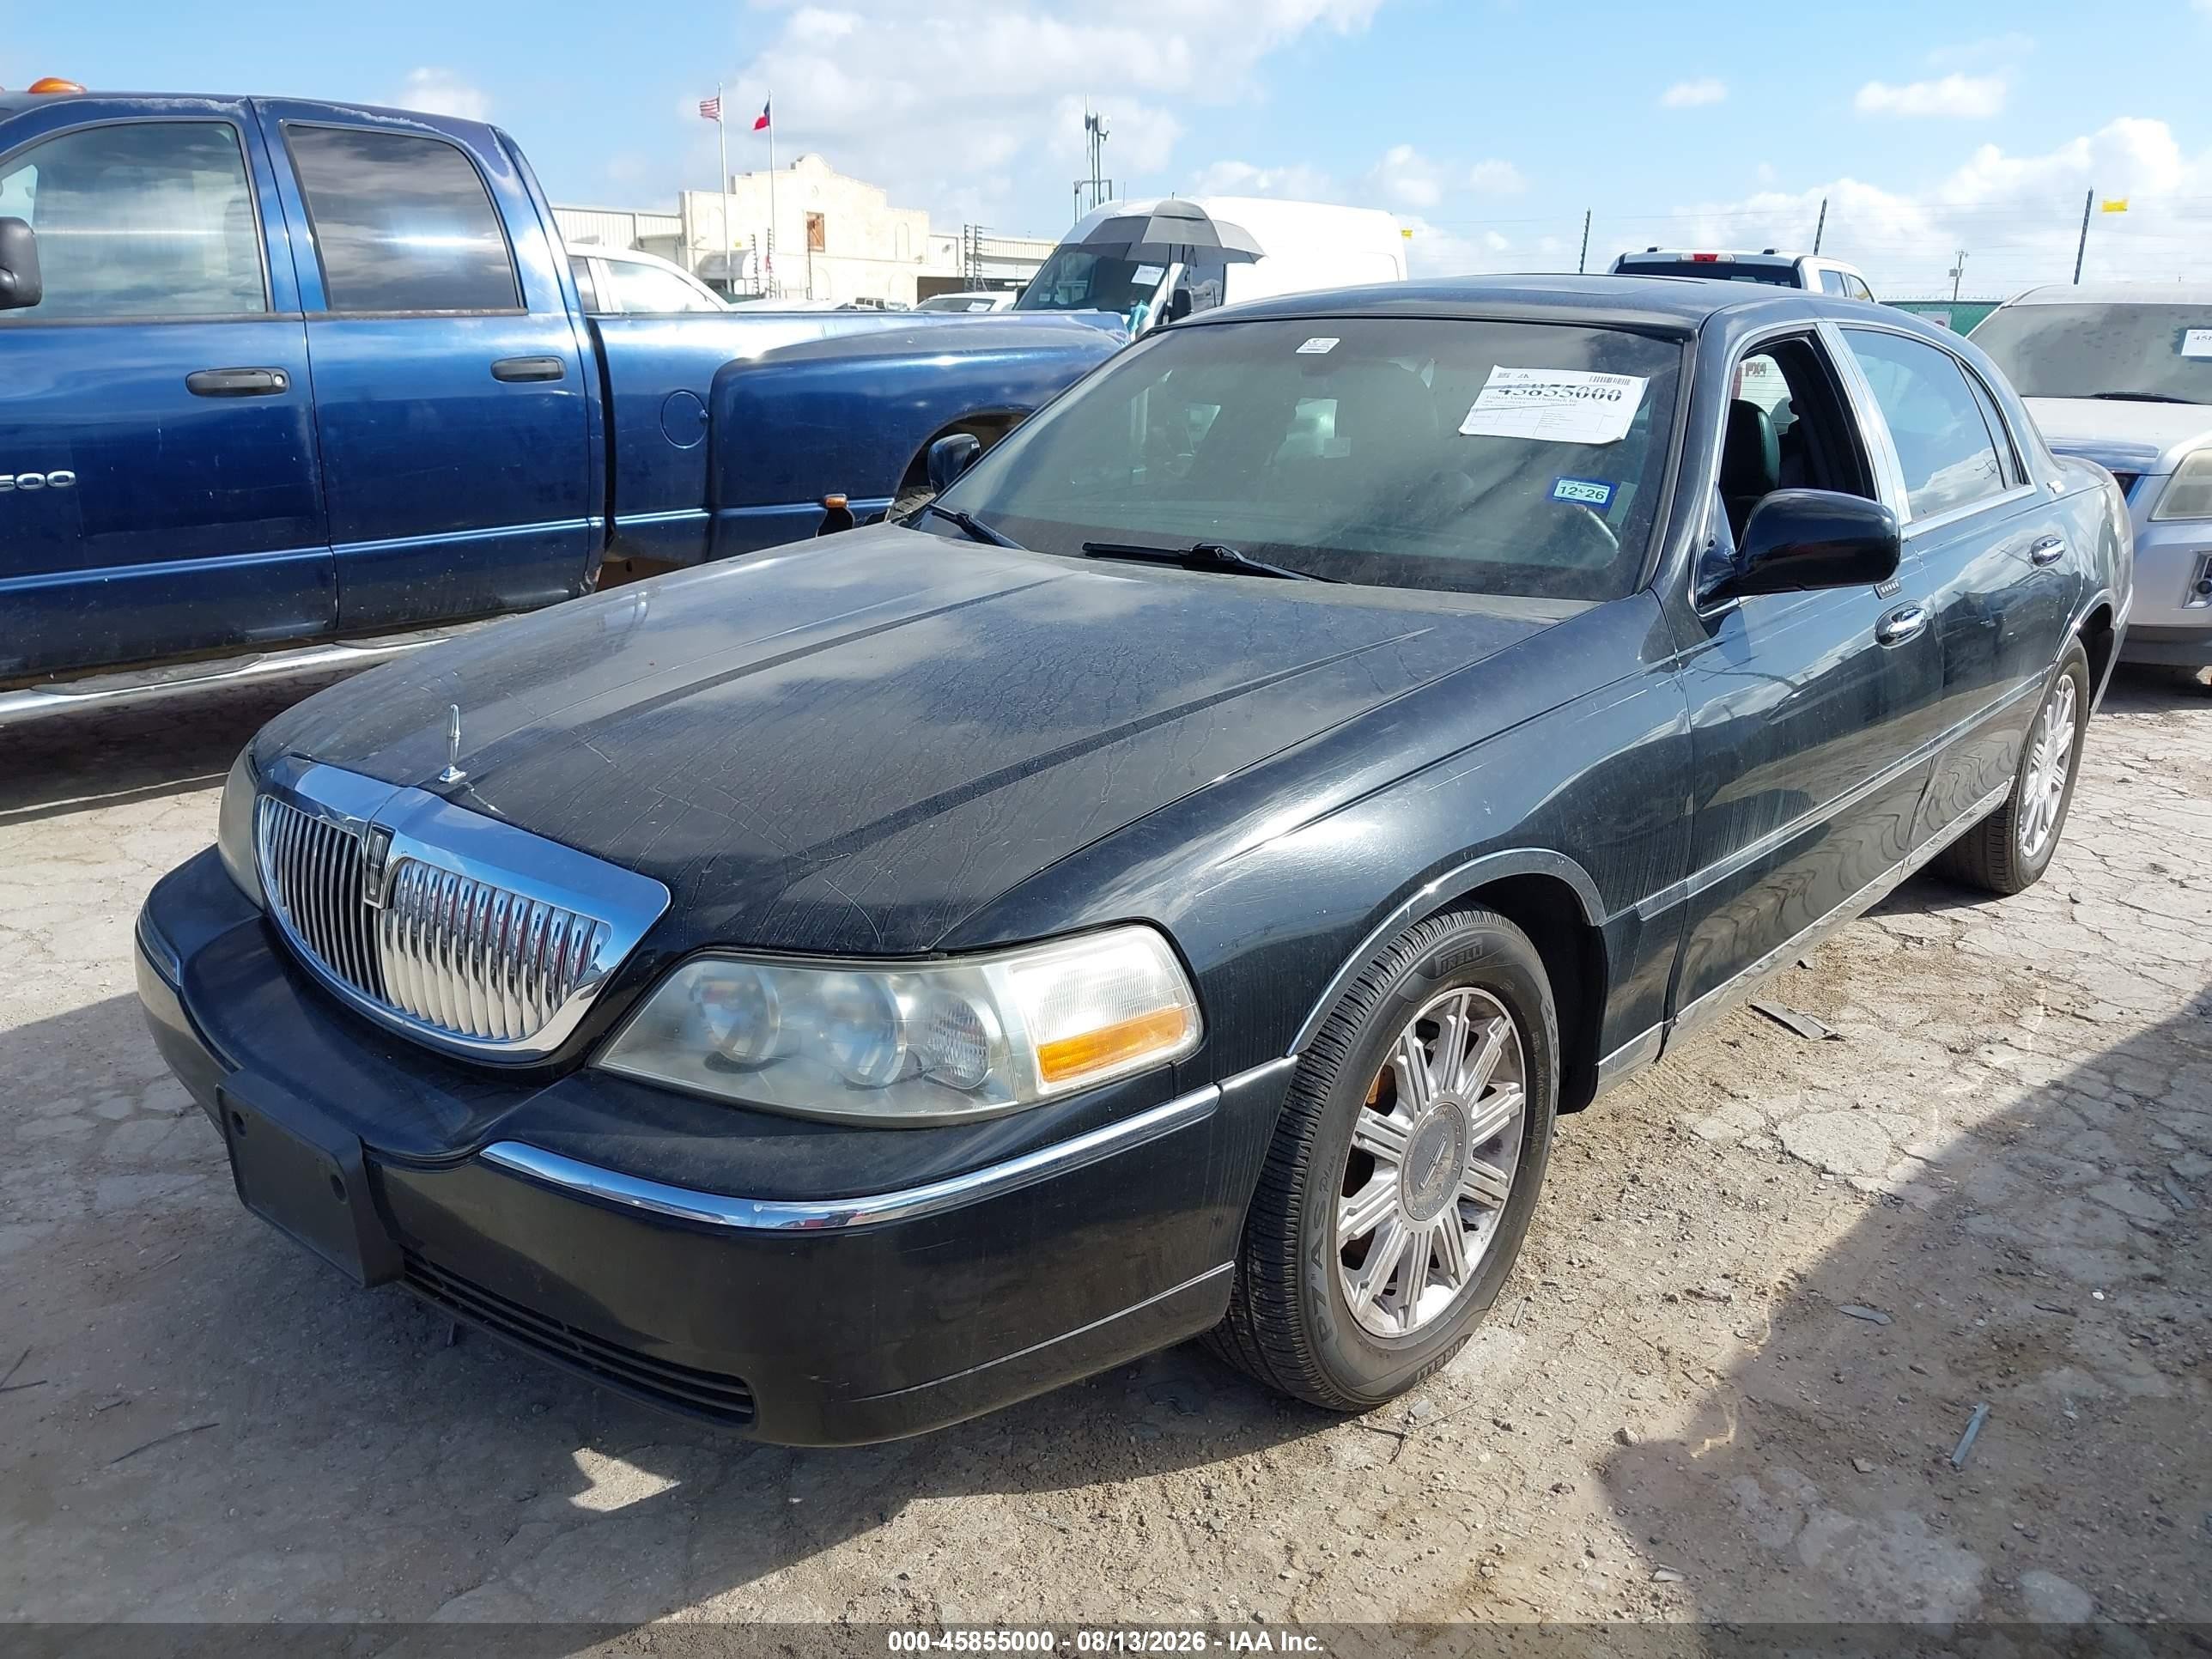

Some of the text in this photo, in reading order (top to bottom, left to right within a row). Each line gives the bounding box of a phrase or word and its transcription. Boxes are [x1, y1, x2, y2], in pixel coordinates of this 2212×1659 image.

[1560, 486, 1578, 495] 12
[1585, 489, 1606, 500] 26
[1434, 936, 1483, 977] PIRELLI
